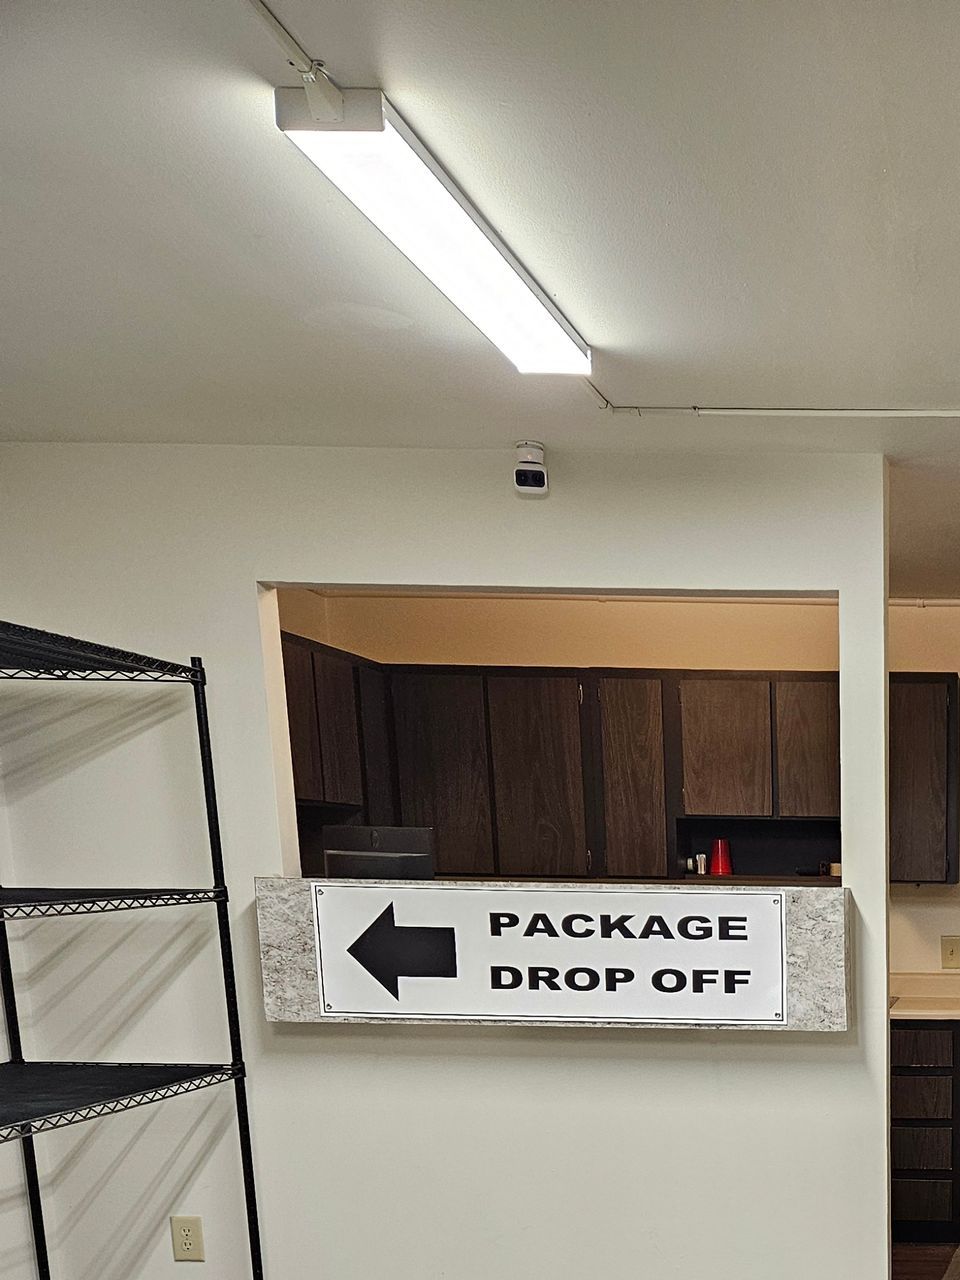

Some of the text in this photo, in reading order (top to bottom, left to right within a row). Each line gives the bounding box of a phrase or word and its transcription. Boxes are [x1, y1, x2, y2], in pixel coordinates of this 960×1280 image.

[489, 911, 749, 942] PACKAGE
[489, 965, 752, 994] DROP OFF
